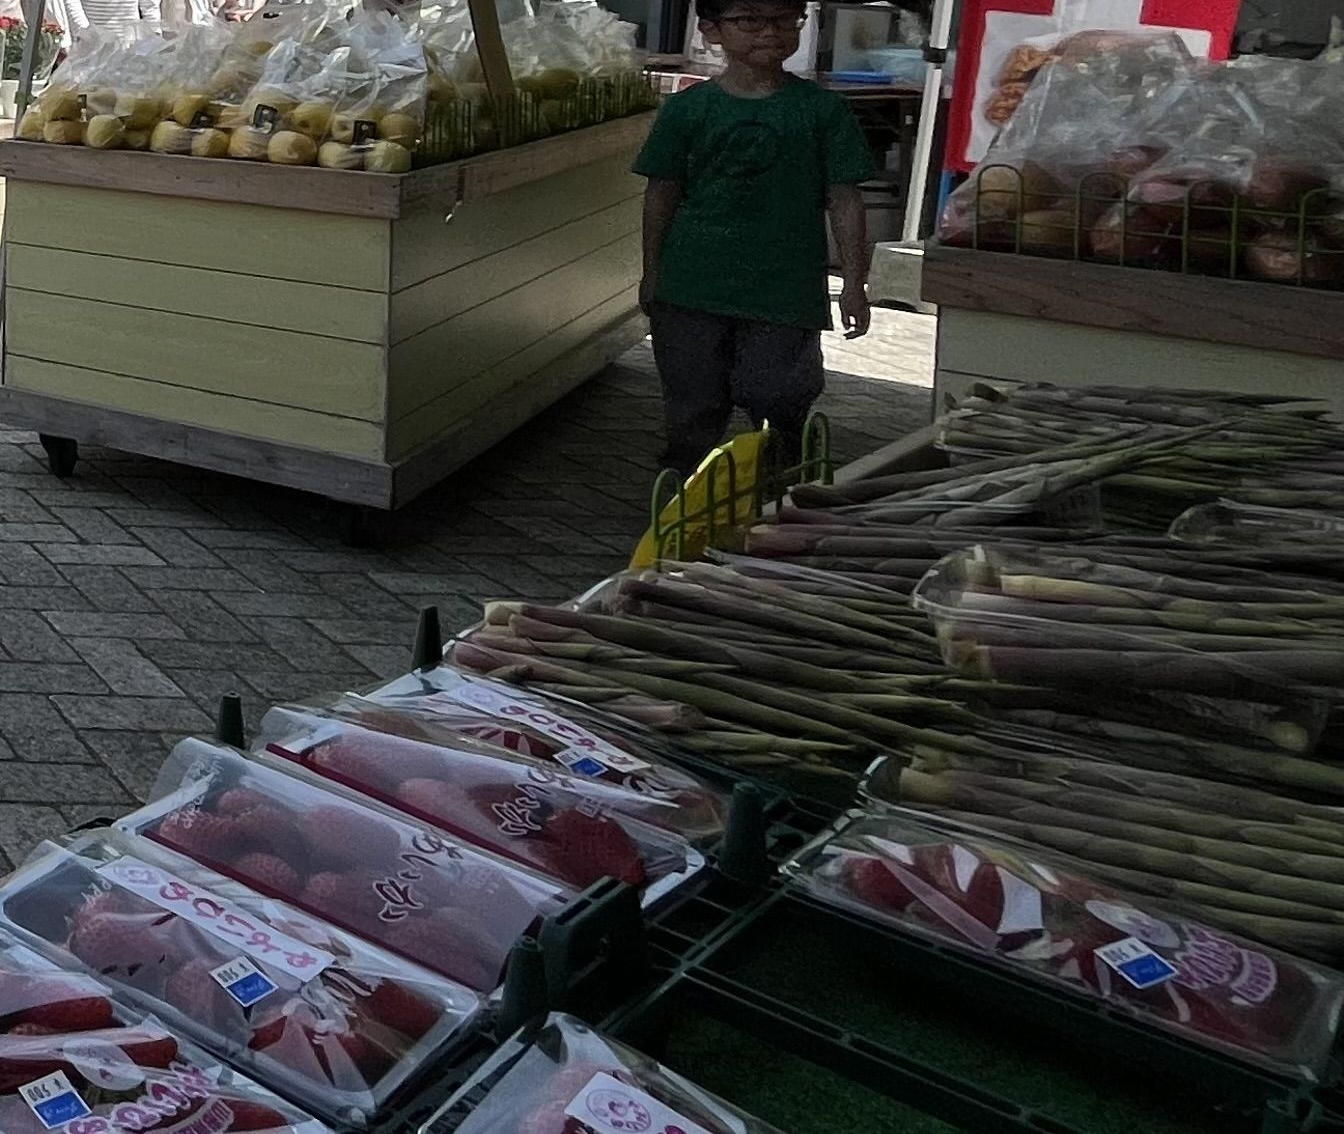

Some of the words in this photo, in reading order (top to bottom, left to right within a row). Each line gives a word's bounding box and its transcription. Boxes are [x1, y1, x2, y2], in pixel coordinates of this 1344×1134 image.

[159, 880, 319, 971] やよいひめ
